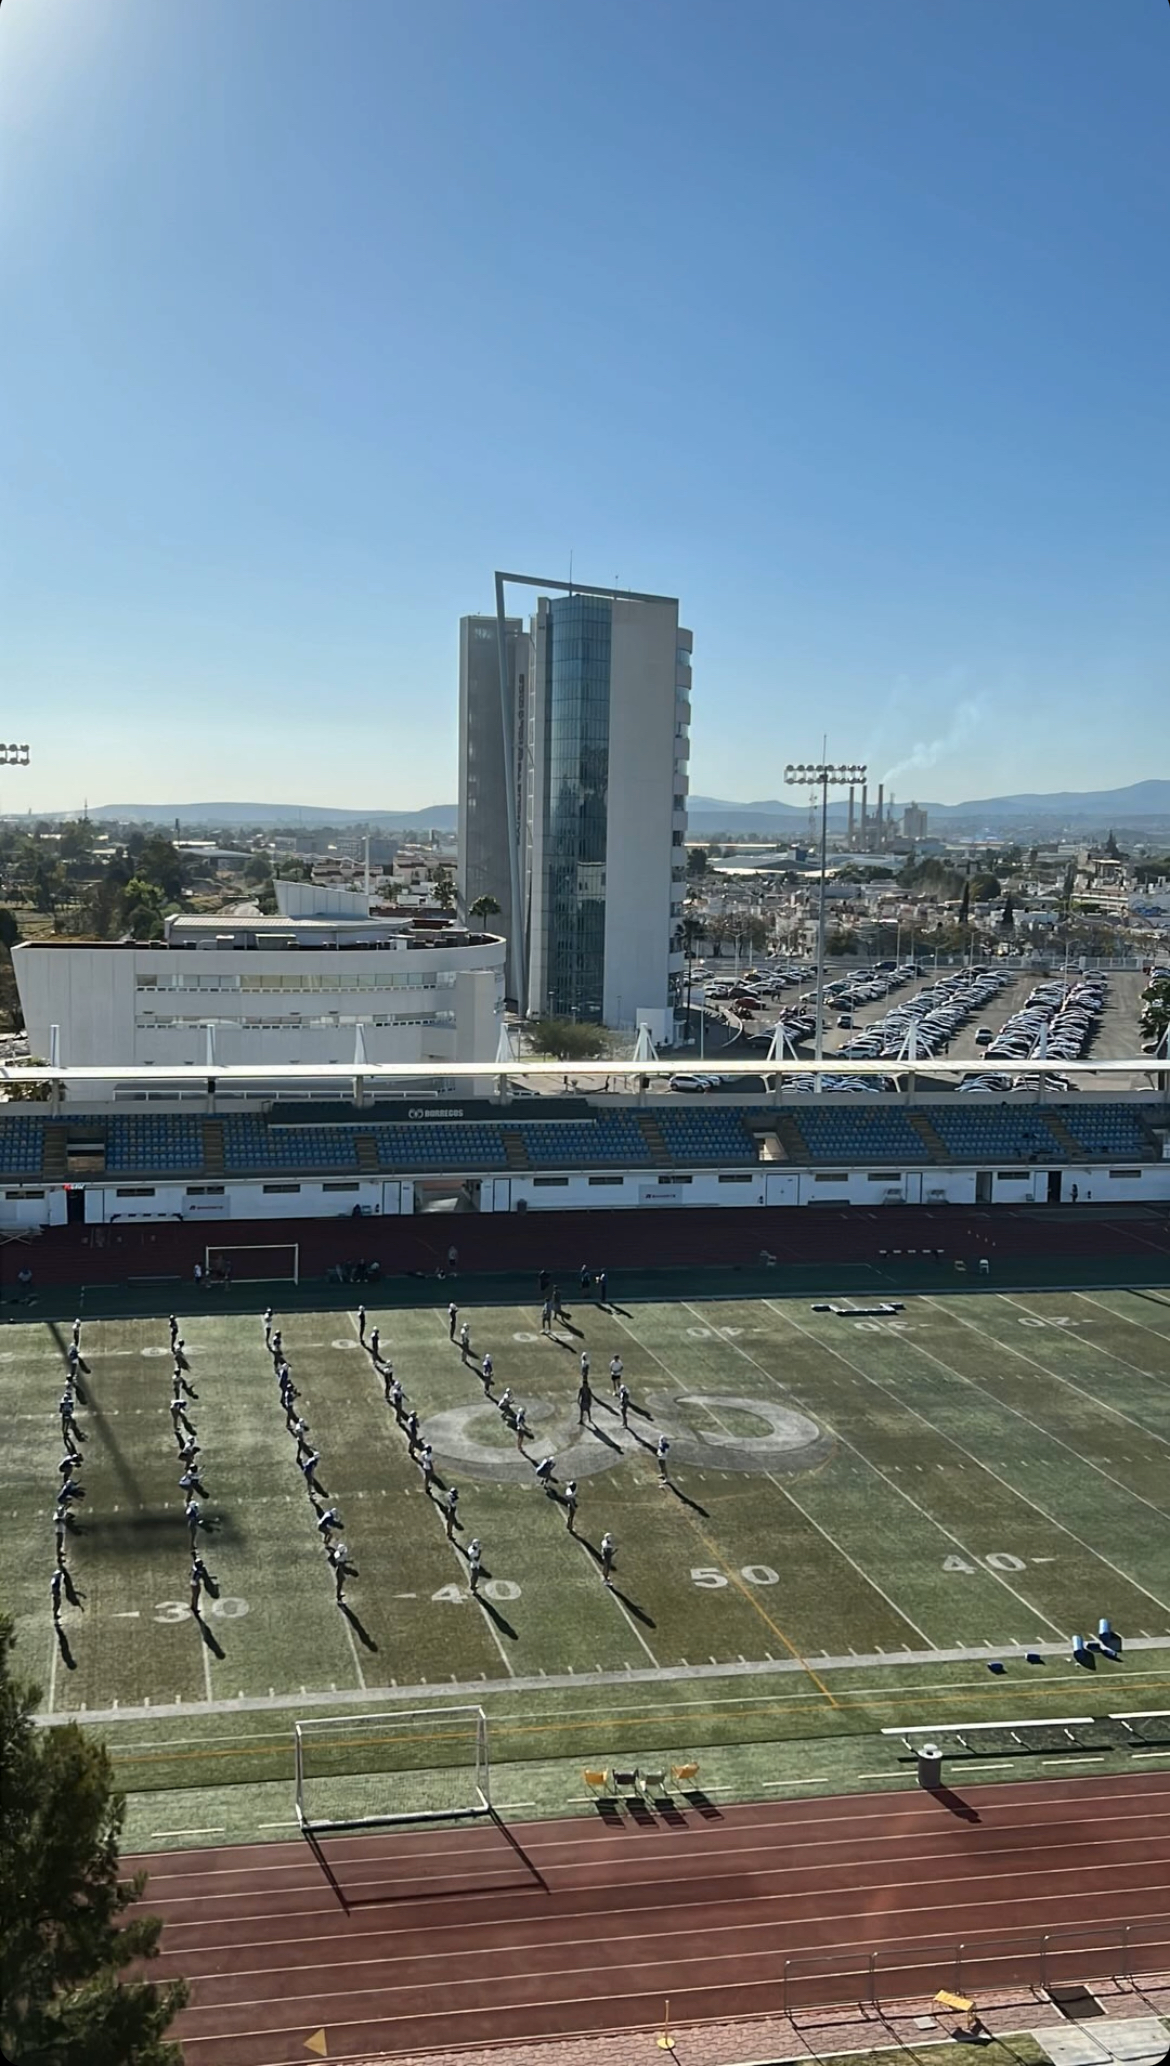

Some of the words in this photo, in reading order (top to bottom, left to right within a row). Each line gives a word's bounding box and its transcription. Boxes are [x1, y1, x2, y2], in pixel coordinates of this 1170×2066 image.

[942, 1553, 1027, 1574] 40
[690, 1564, 780, 1589] 50
[431, 1580, 522, 1605] 40
[153, 1597, 250, 1623] 30
